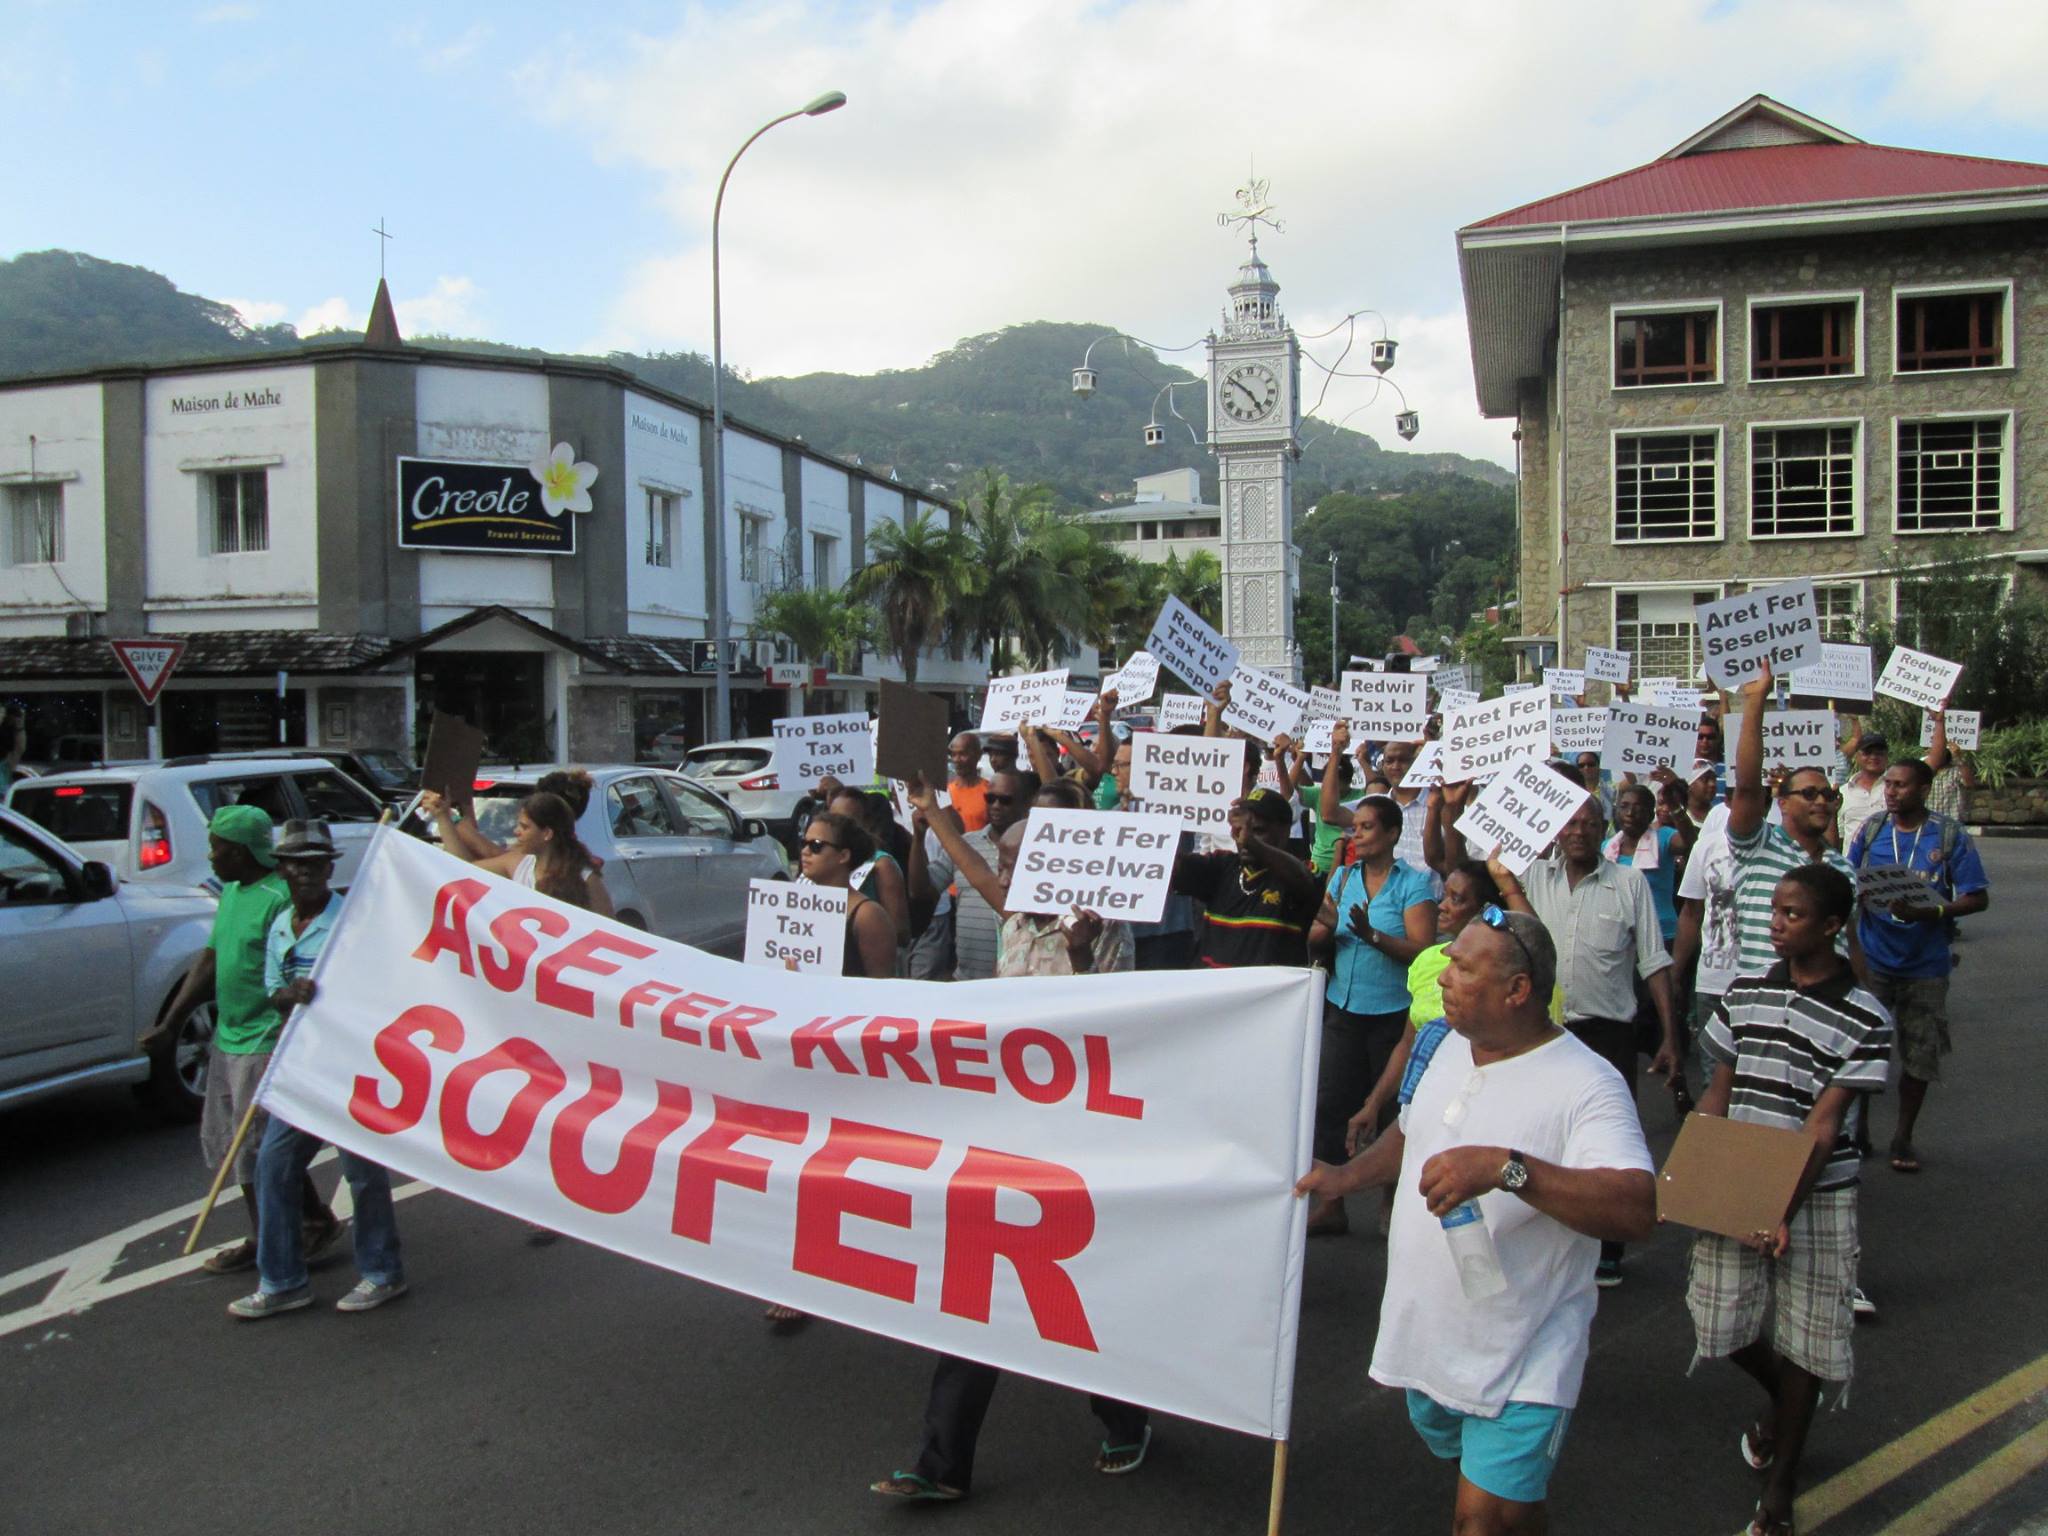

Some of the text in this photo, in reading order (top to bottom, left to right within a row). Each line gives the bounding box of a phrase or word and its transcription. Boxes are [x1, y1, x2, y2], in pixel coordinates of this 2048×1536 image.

[171, 388, 281, 413] Maison de Mahe
[632, 414, 658, 435] Maison
[660, 422, 668, 440] de
[412, 476, 529, 520] Creole
[487, 529, 561, 542] Travel Services
[1706, 592, 1806, 632] Aret Fer
[1172, 609, 1228, 661] Redwir
[1708, 617, 1812, 656] Seselwa
[131, 651, 167, 661] GIVE
[1168, 624, 1219, 676] Tax Lo
[1603, 651, 1631, 662] Bokou
[1724, 644, 1804, 677] Soufer
[138, 664, 160, 672] WAY
[781, 669, 801, 679] ATM
[1151, 633, 1213, 693] Transpo
[1594, 669, 1620, 678] Sesel
[1600, 660, 1616, 668] Tax
[1900, 653, 1951, 677] Redwir
[990, 677, 1066, 693] Tro Bokou
[1231, 666, 1310, 710] Tro Bokou
[1351, 679, 1415, 693] Redwir
[1896, 666, 1942, 690] Tax Lo
[1011, 694, 1042, 705] Tax
[1063, 707, 1080, 716] Lo
[1167, 699, 1185, 709] Aret
[1245, 689, 1275, 713] Tax
[1352, 698, 1384, 712] Tax
[1391, 699, 1413, 713] Lo
[1000, 706, 1047, 721] Sesel
[1227, 700, 1275, 732] Sesel
[1453, 698, 1546, 731] Aret Fer
[1555, 714, 1583, 723] Aret
[1609, 708, 1700, 732] Tro Bokou
[1957, 715, 1976, 723] Fer
[773, 720, 870, 738] Tro Bokou
[1450, 719, 1547, 752] Seselwa
[1635, 730, 1670, 747] Tax
[1761, 721, 1823, 737] edwir
[806, 741, 844, 756] Tax
[1561, 737, 1604, 748] Soufer
[1762, 741, 1822, 757] ax Lo
[799, 759, 855, 777] Sesel
[1145, 744, 1230, 768] Redwir
[1621, 748, 1676, 768] Sesel
[1145, 771, 1225, 795] Tax Lo
[1513, 763, 1574, 811] Redwir
[1131, 797, 1226, 825] Transpo
[1497, 786, 1551, 833] Tax Lo
[1033, 822, 1170, 849] Aret Fer
[1469, 802, 1537, 863] Transpor
[1025, 851, 1165, 880] Seselwa
[749, 888, 846, 914] Tro Bokou
[1033, 882, 1144, 910] Soufer
[776, 915, 814, 937] Tax
[764, 940, 822, 965] Sesel
[412, 878, 1145, 1121] ASE FER KREOL
[348, 1004, 1100, 1353] SOUFER
